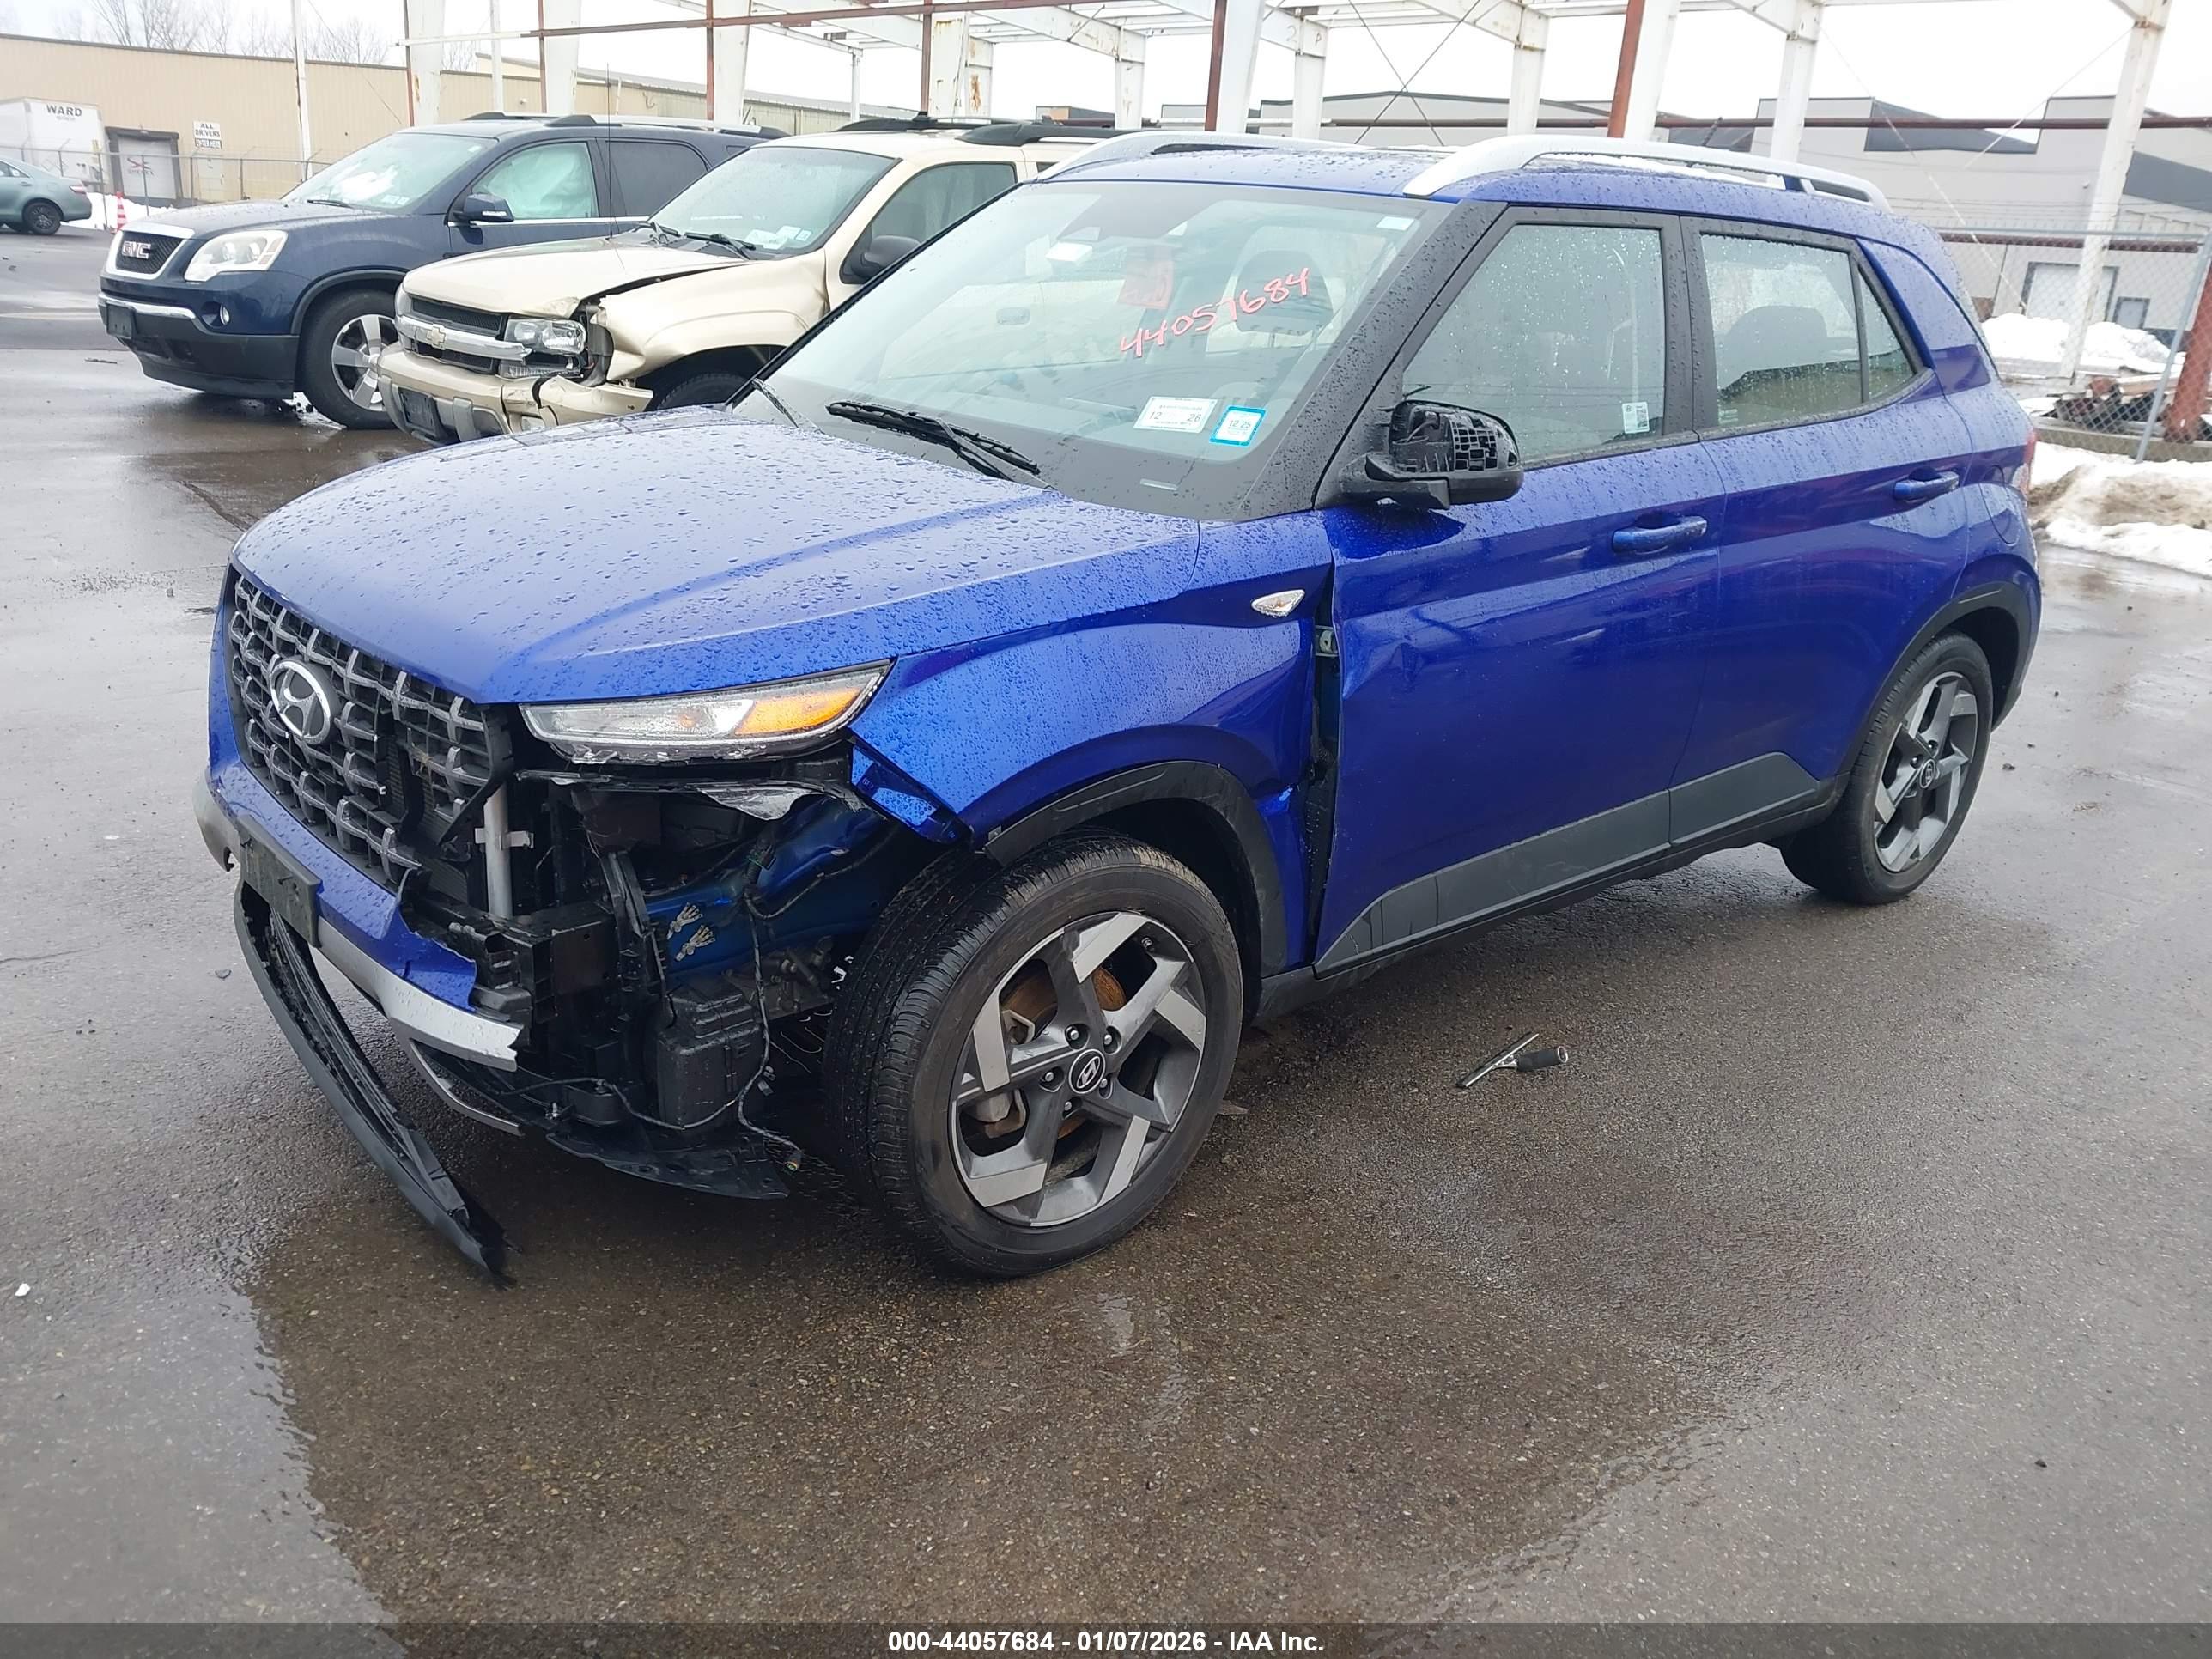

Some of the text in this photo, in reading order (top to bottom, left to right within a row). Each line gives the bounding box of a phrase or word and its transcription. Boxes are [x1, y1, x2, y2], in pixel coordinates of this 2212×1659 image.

[46, 104, 82, 117] WARD
[195, 129, 220, 137] DRIVERS
[122, 240, 151, 259] GMC
[1120, 267, 1310, 357] 44057684
[1149, 411, 1162, 420] 12
[1186, 413, 1202, 423] 26
